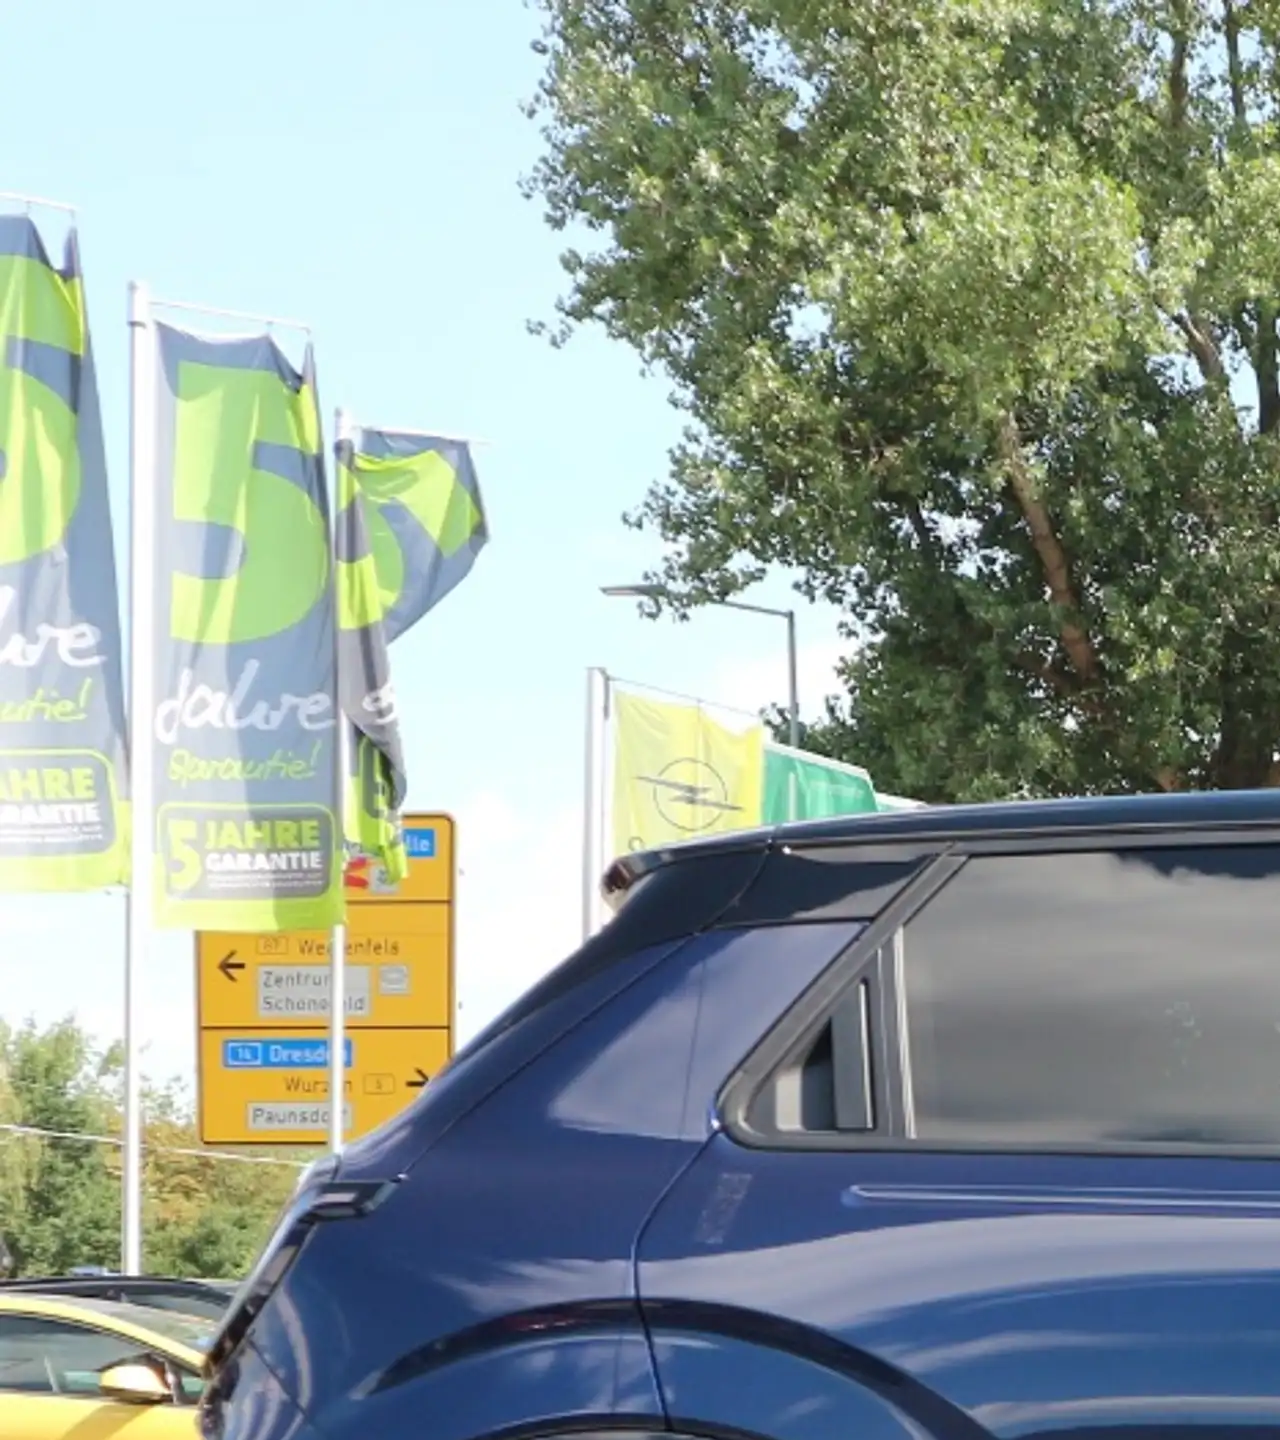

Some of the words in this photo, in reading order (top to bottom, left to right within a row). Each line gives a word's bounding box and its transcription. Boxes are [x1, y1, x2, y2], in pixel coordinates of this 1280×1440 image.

[169, 359, 328, 645] 5
[0, 767, 96, 802] HRE
[166, 817, 203, 891] 5
[204, 818, 321, 850] JAHRE
[205, 851, 324, 872] GARANTIE
[298, 937, 399, 956] Weenfels
[262, 970, 330, 989] Zentru
[269, 1044, 348, 1063] Dresd
[284, 1075, 352, 1093] Wurzn
[252, 1107, 348, 1125] Paunsdo
